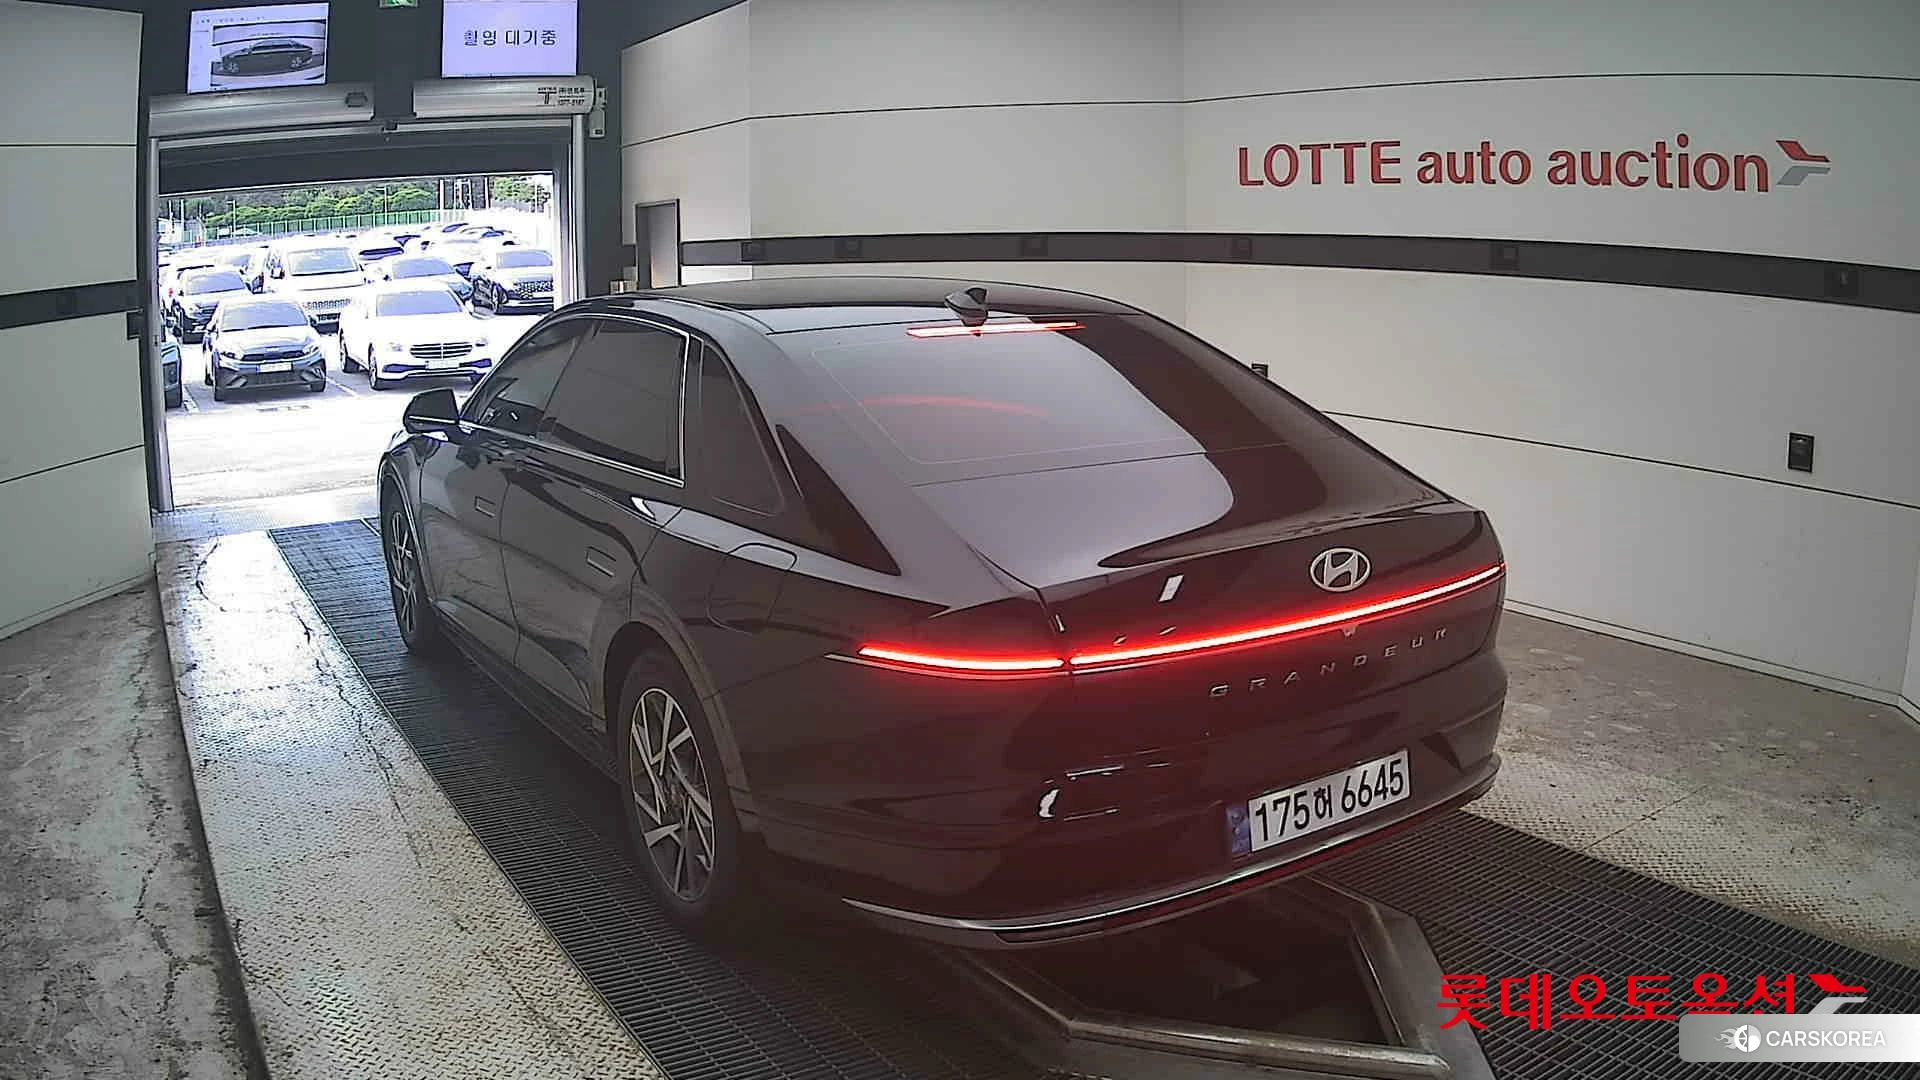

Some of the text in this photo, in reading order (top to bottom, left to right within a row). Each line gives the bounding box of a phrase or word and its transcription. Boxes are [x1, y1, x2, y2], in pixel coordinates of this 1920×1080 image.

[505, 29, 557, 46] 대기중
[1239, 133, 1768, 192] LOTTE auto auction
[1209, 627, 1448, 697] GRANDEUR
[1256, 759, 1403, 841] 175허 6645
